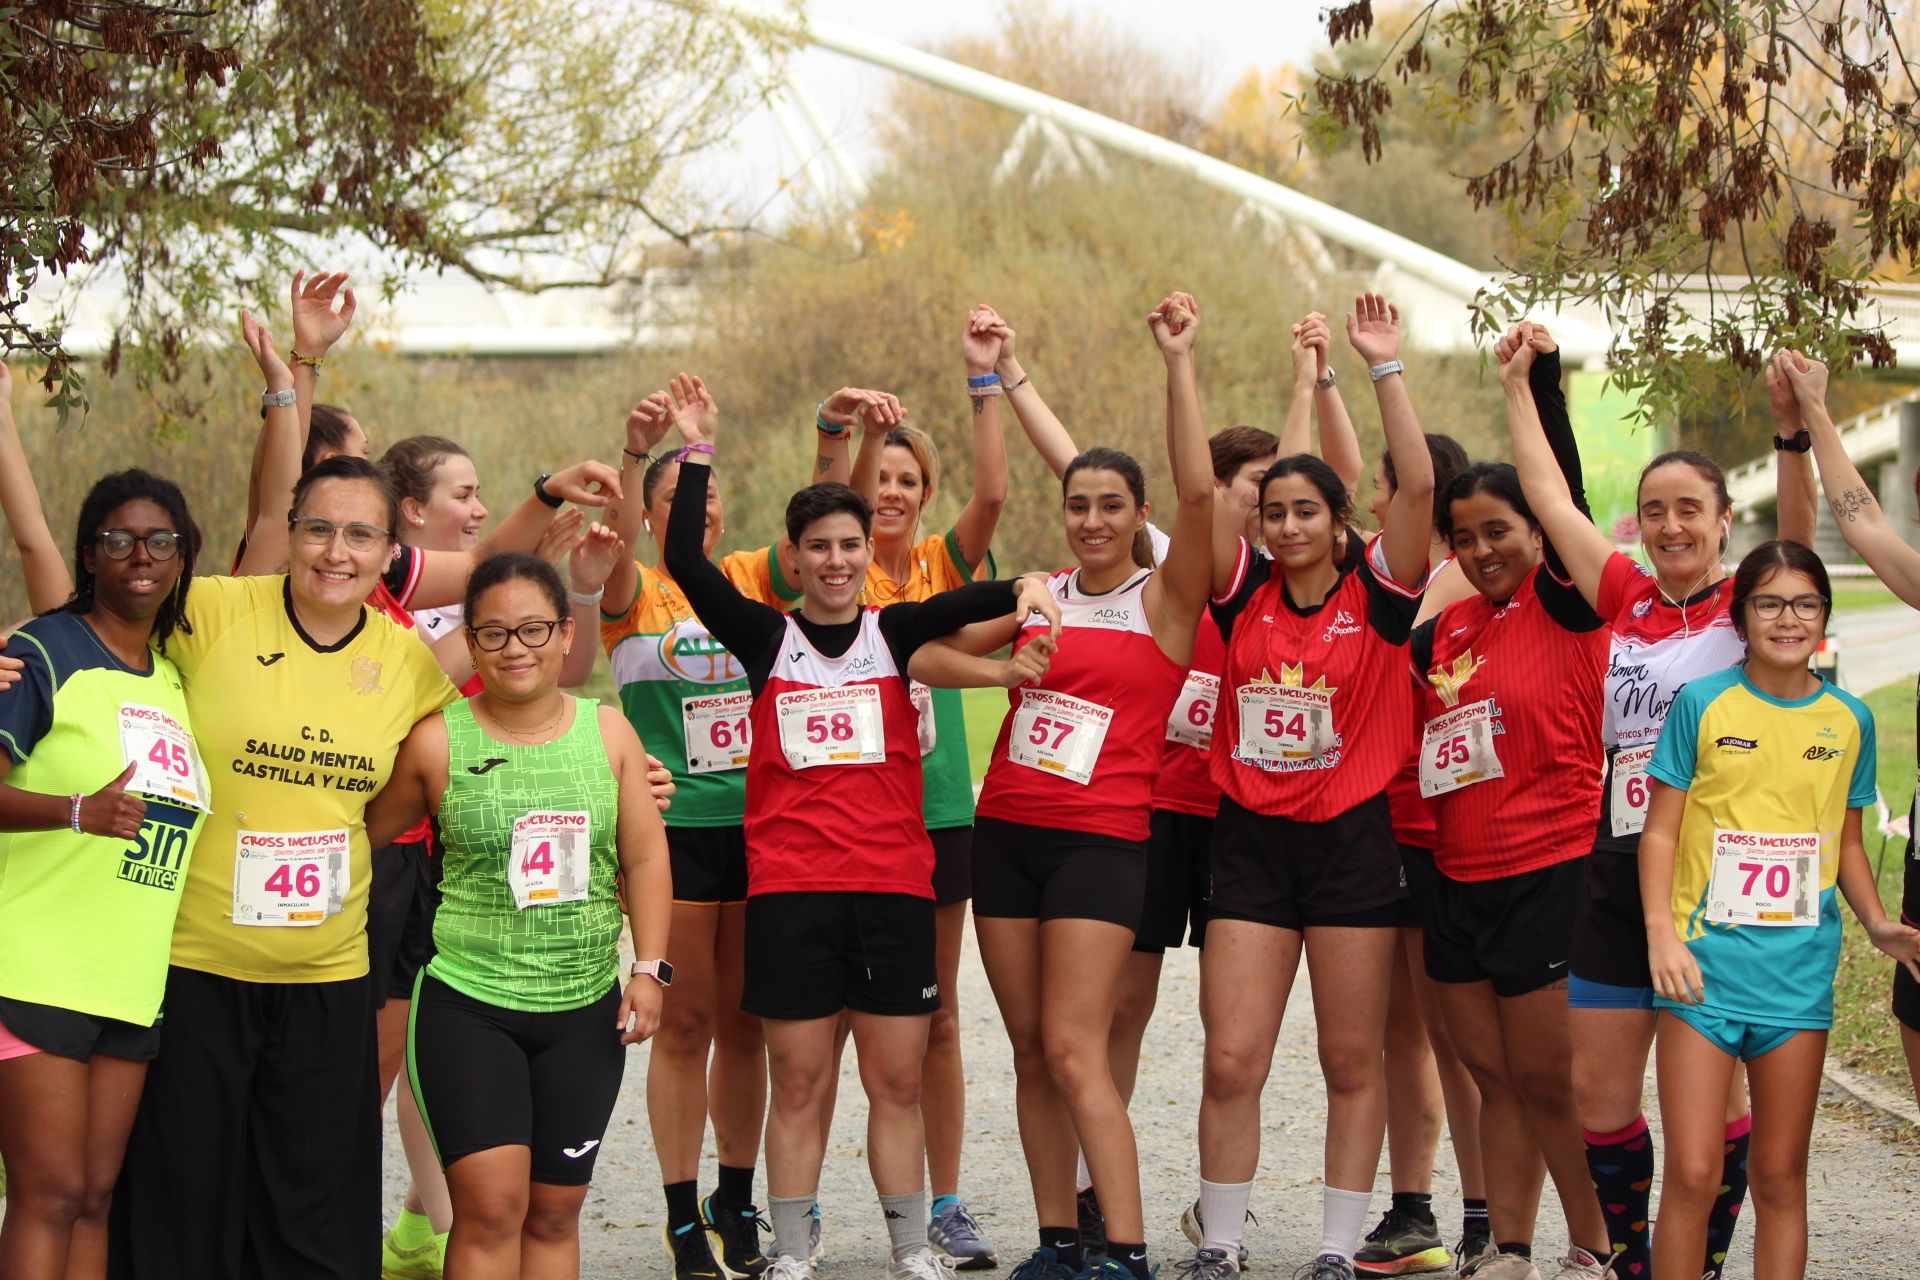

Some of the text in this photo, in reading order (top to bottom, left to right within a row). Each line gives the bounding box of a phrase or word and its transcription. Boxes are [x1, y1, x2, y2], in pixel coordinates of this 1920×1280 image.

[1094, 609, 1129, 620] ADAS
[780, 688, 876, 705] CROSS INCLUSIVO
[1025, 691, 1054, 703] CROSS
[1055, 697, 1109, 720] INCLUSIVO
[1240, 686, 1277, 695] CROSS
[1279, 688, 1328, 703] INCLUSIVO
[121, 707, 160, 721] CROSS
[807, 713, 854, 744] 58
[1264, 709, 1306, 742] 54
[1427, 720, 1448, 735] CROSS
[1449, 706, 1486, 725] INCLUSIVO
[301, 725, 334, 744] C. D.
[710, 717, 748, 748] 61
[1029, 716, 1075, 750] 57
[148, 738, 189, 777] 45
[245, 739, 375, 772] SALUD MENTAL
[1435, 735, 1470, 770] 55
[1615, 752, 1634, 767] CROSS
[232, 758, 378, 793] CASTILLA Y LEÓN
[241, 833, 346, 847] CROSS INCLUSIVO
[1718, 834, 1817, 847] CROSS INCLUSIVO
[264, 863, 321, 898] 46
[1738, 862, 1790, 898] 70
